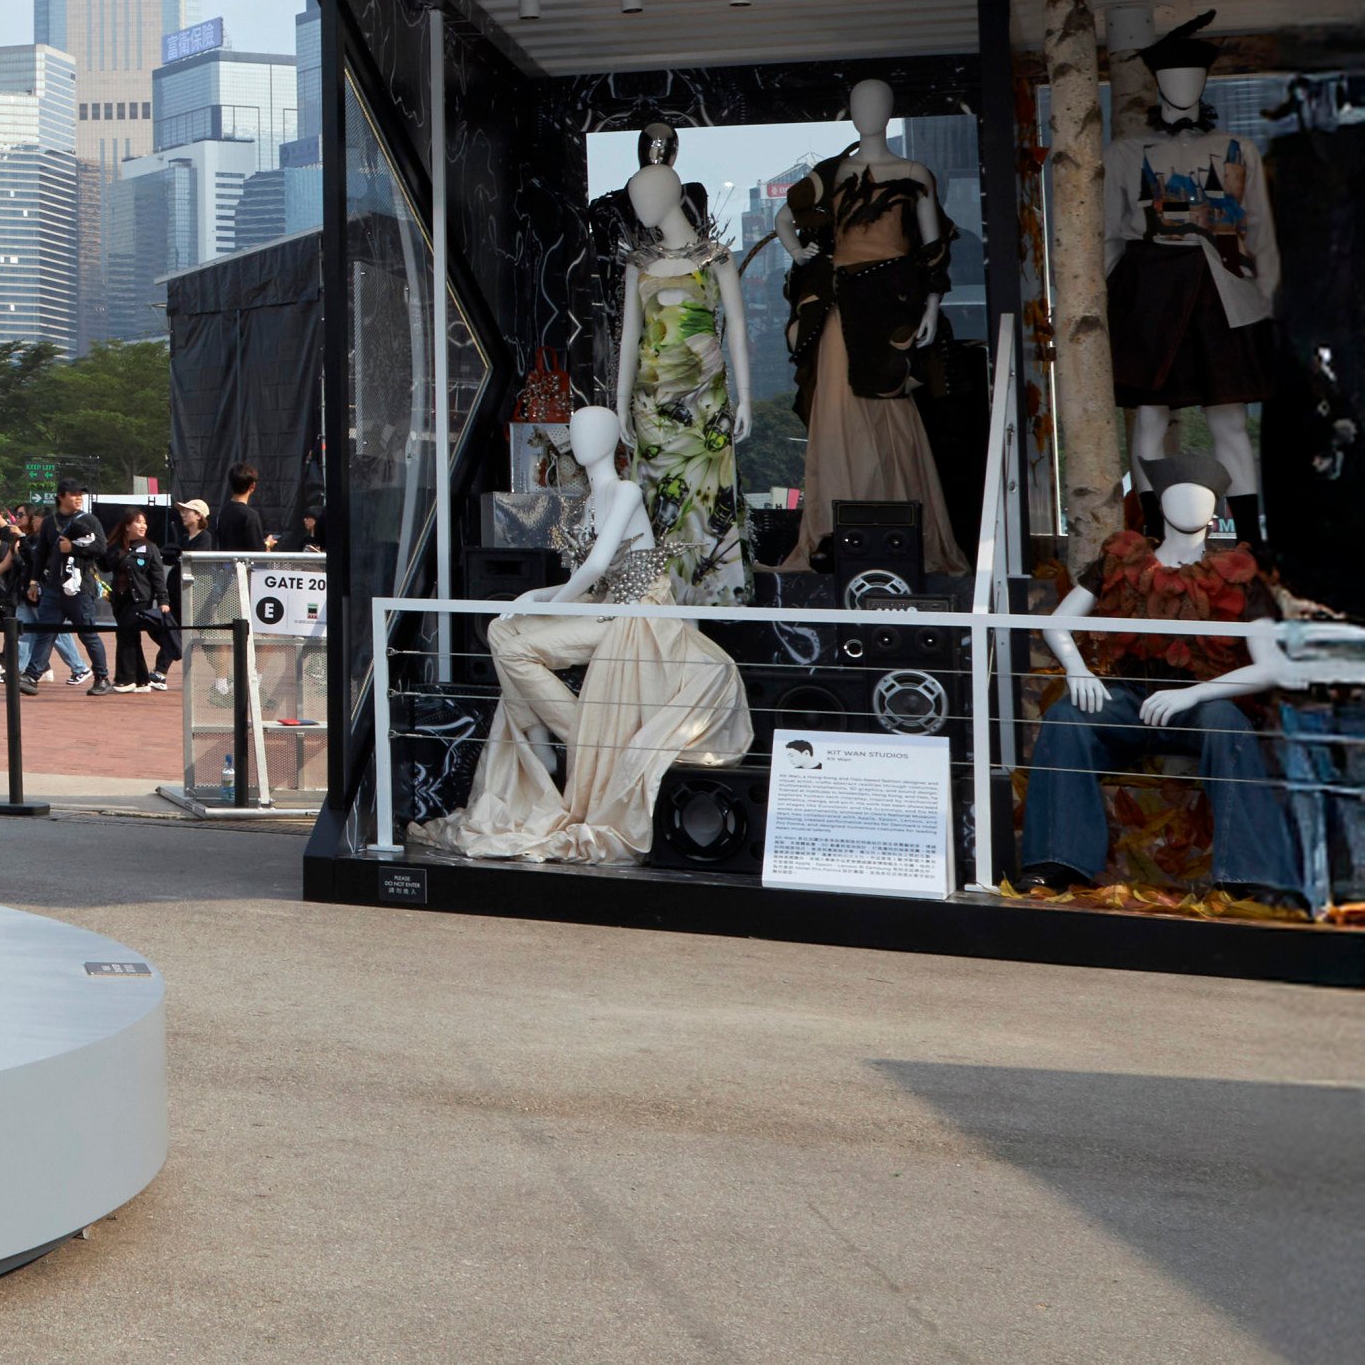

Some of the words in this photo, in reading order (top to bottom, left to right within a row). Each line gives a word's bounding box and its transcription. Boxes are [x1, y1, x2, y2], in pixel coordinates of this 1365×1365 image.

[265, 576, 303, 589] GATE
[309, 579, 326, 590] 20
[265, 603, 274, 618] E
